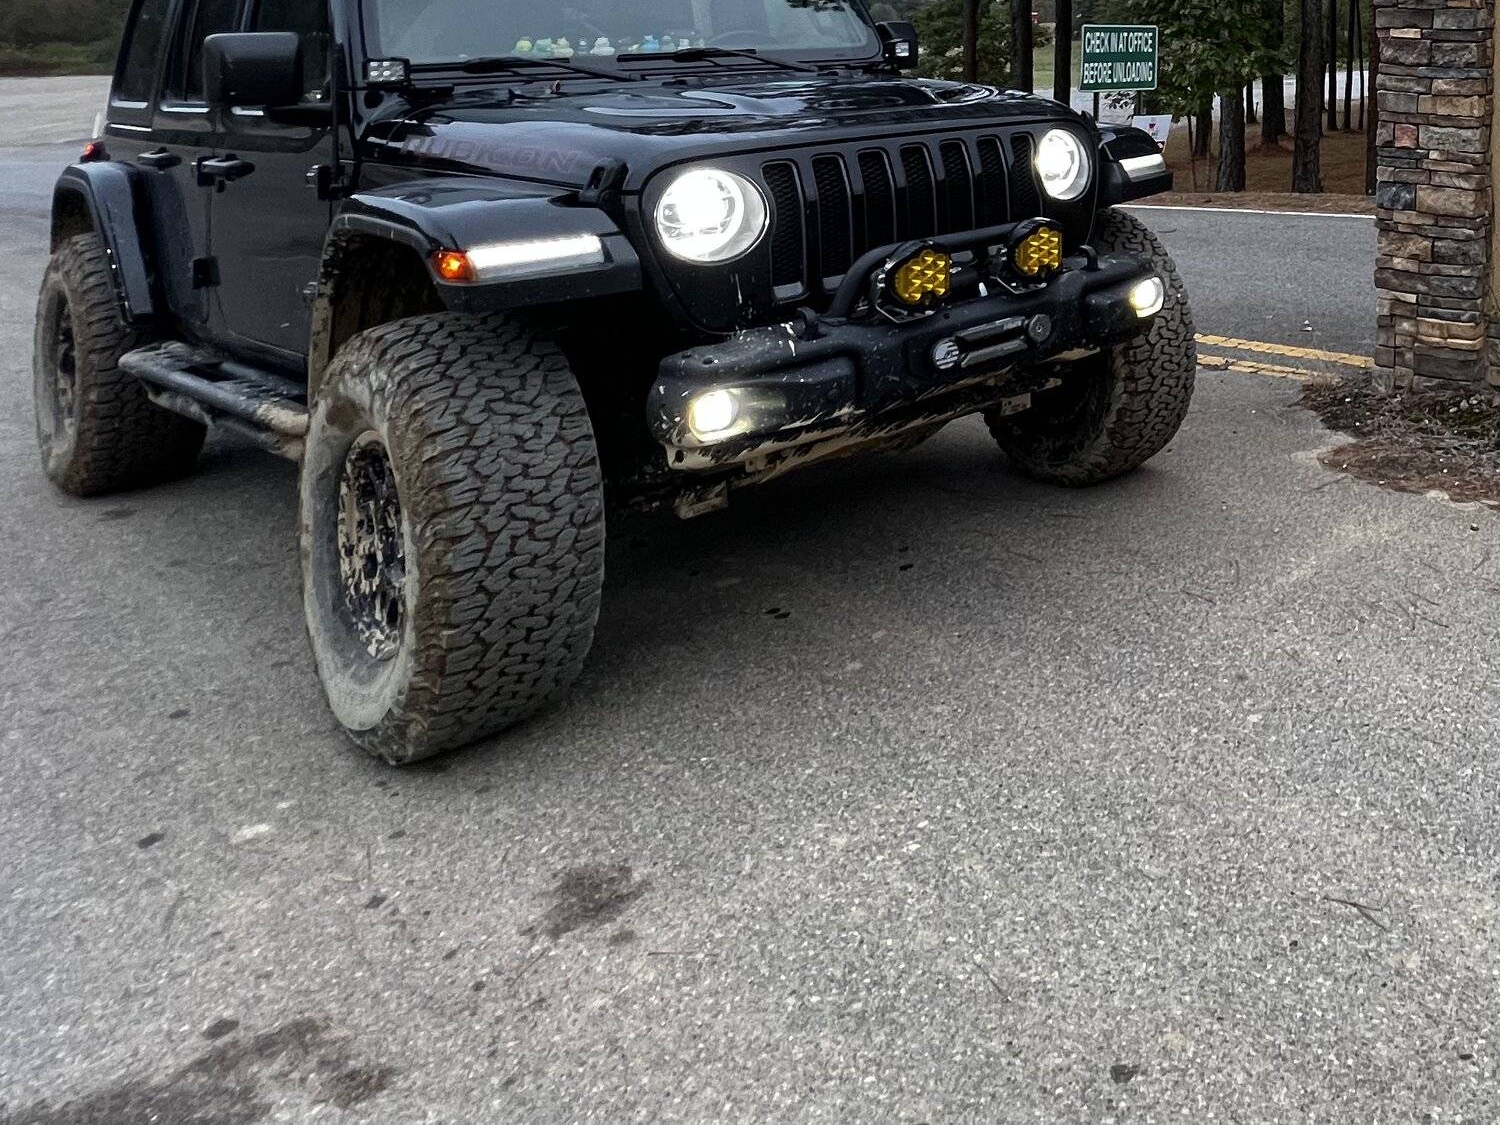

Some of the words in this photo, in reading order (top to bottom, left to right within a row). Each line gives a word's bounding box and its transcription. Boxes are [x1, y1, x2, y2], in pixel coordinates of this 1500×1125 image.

[1085, 31, 1109, 53] CHECK
[1110, 32, 1119, 53] IN
[1118, 32, 1128, 53] AT
[1128, 31, 1153, 53] OFFICE
[1083, 62, 1112, 84] BEFORE
[1113, 61, 1153, 83] UNLOADING
